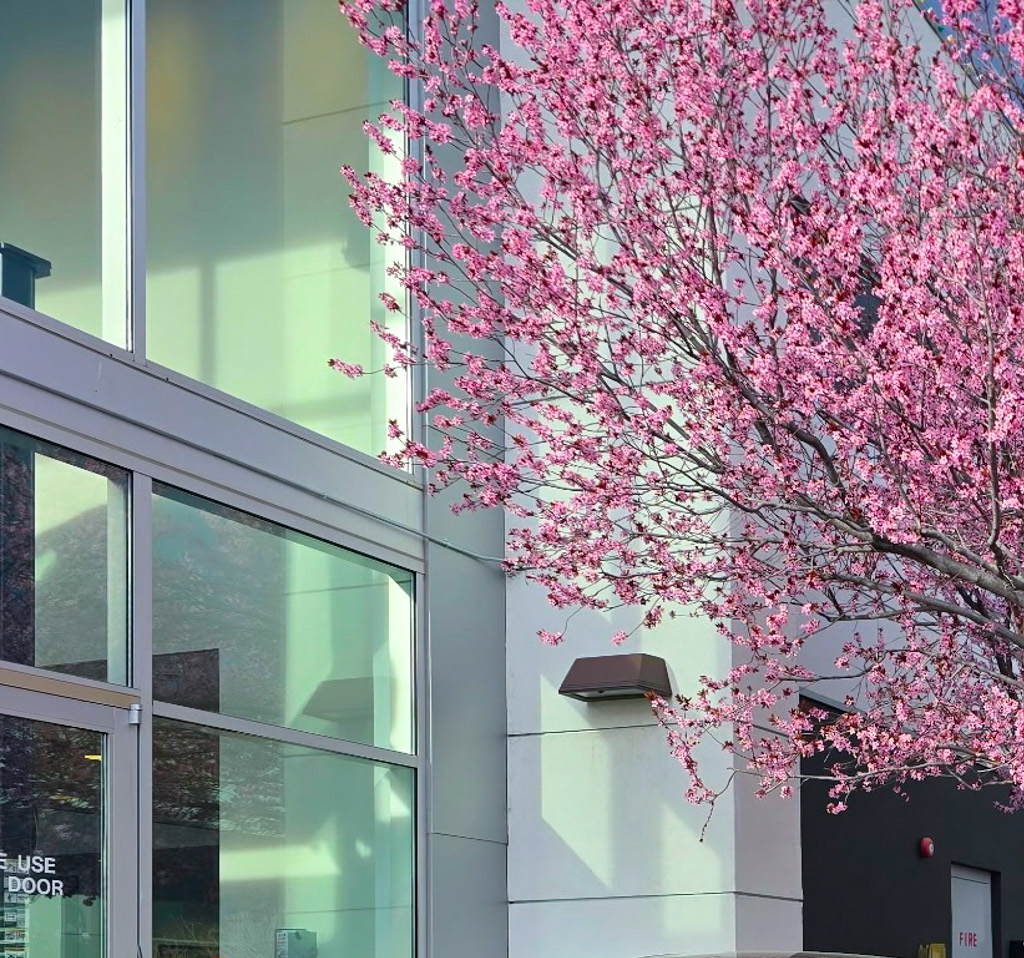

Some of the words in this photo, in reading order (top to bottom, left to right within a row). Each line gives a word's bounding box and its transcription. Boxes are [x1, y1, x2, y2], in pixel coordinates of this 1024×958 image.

[18, 854, 56, 874] USE
[8, 875, 64, 896] DOOR
[959, 932, 978, 947] FIRE
